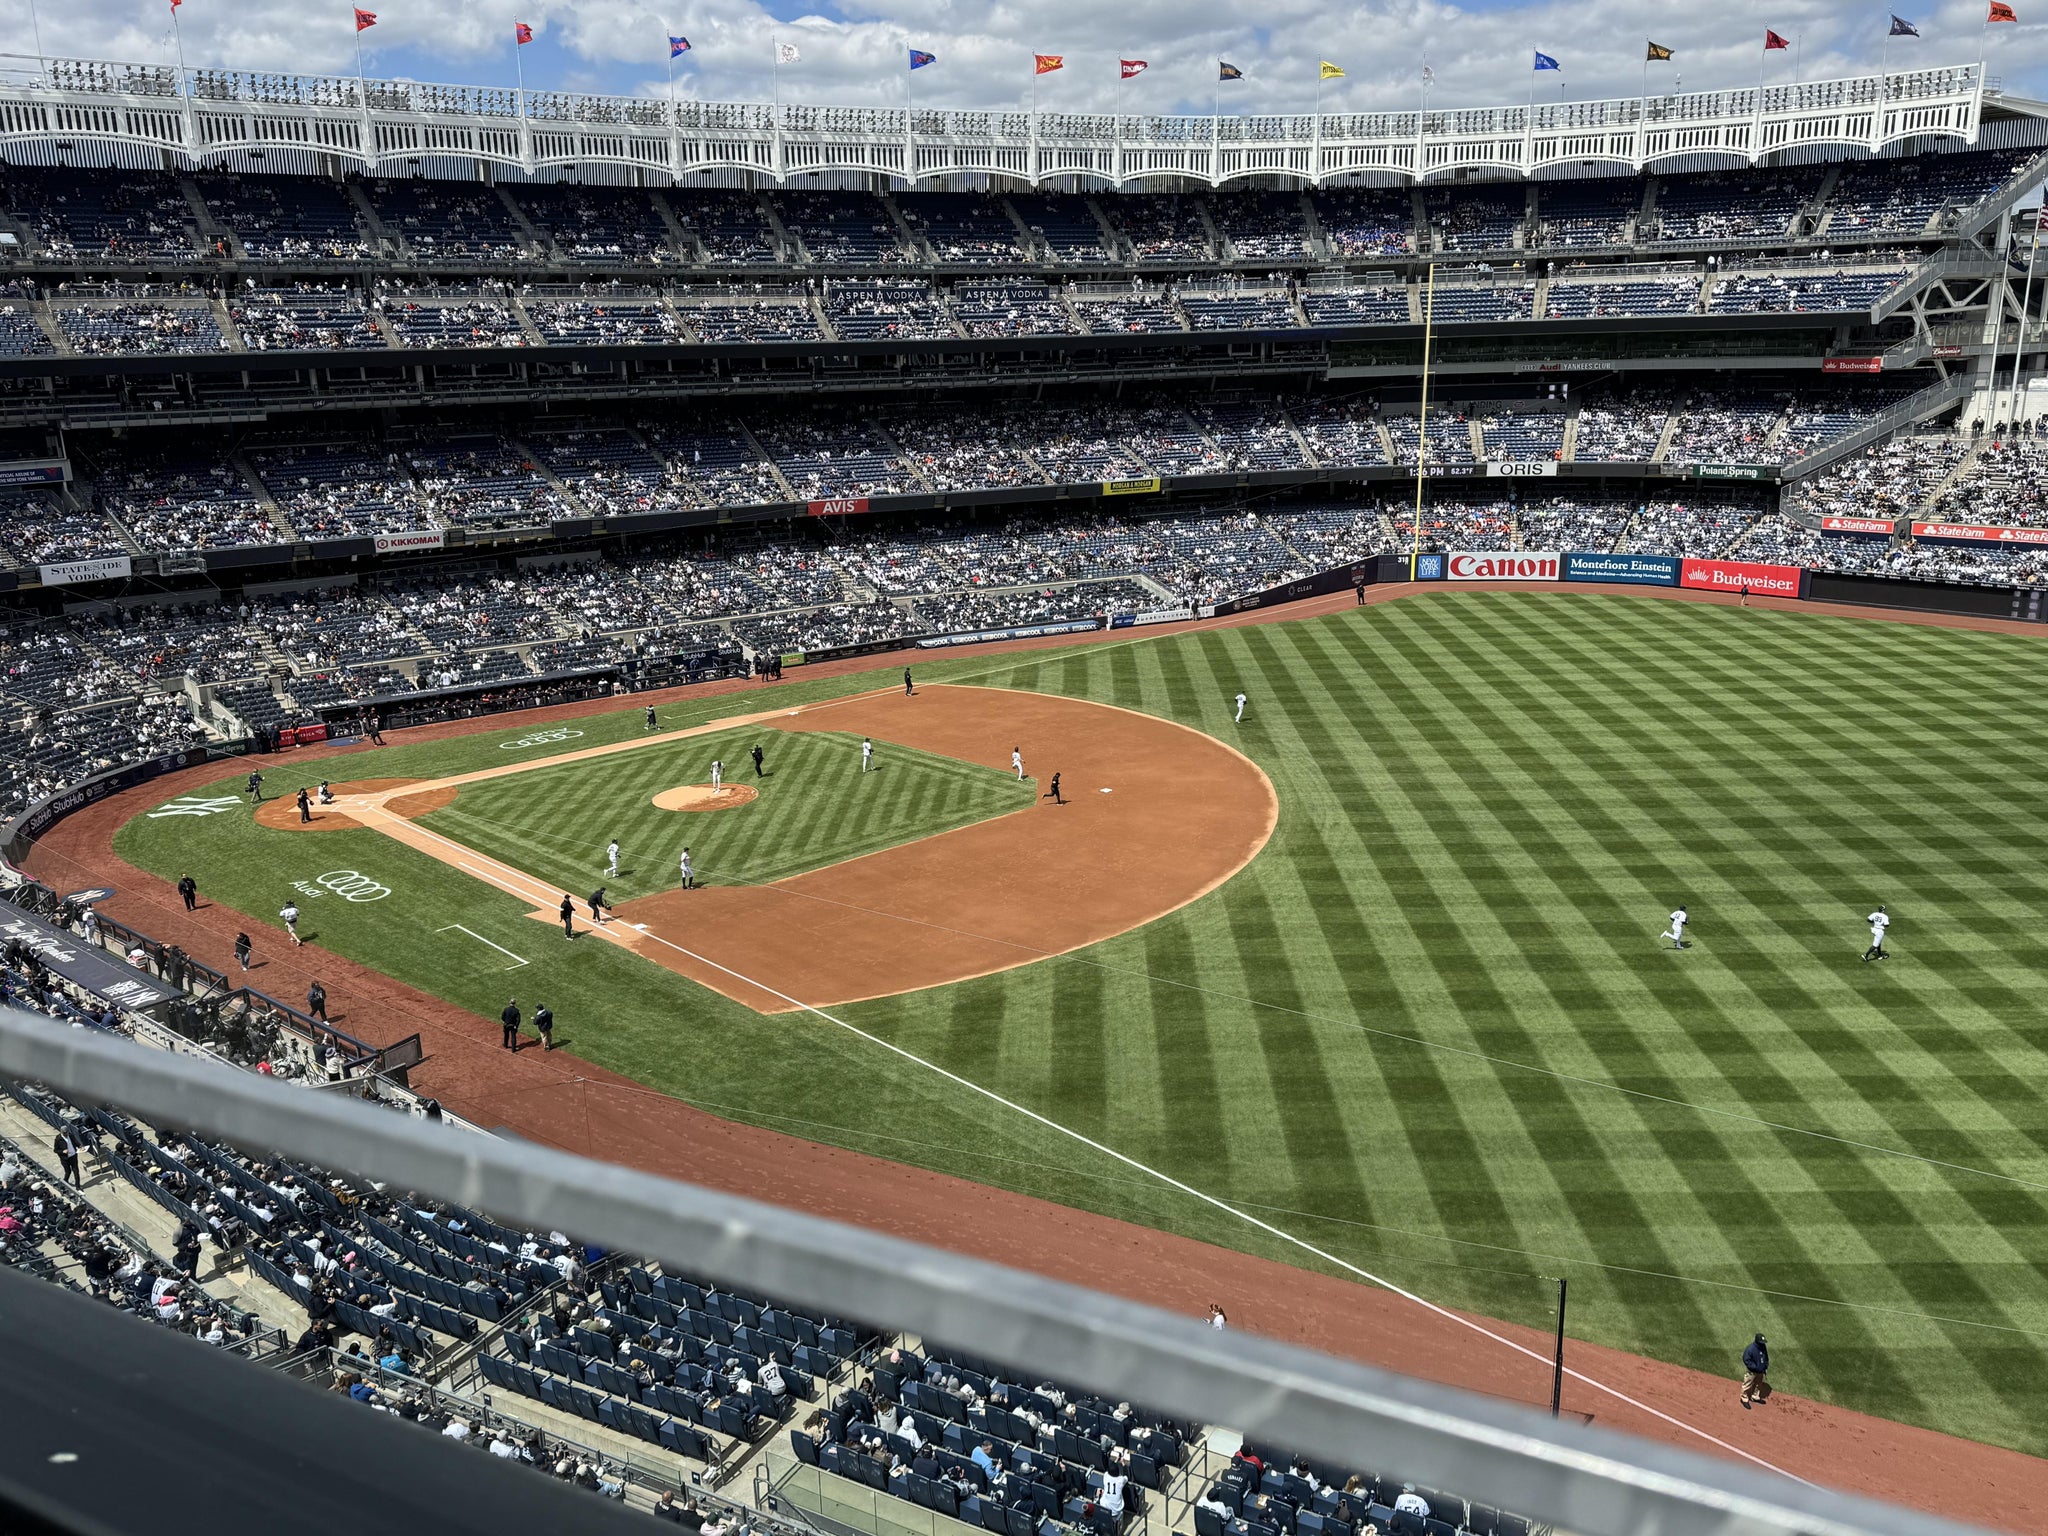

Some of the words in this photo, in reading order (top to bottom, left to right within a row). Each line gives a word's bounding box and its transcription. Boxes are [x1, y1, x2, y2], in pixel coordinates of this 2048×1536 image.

[838, 291, 874, 300] ASPEN
[886, 291, 922, 299] VODKA
[966, 290, 999, 299] ASPEN
[1010, 290, 1044, 298] VODKA
[1539, 363, 1561, 371] Audi
[1564, 362, 1593, 370] YANKEES
[1840, 362, 1879, 370] Budweiser
[1430, 467, 1444, 476] PM
[1500, 463, 1543, 476] ORIS
[1699, 465, 1728, 476] Poland
[1728, 465, 1759, 479] Spring
[822, 501, 855, 513] AVIS
[391, 536, 440, 547] KIKKOMAN
[51, 561, 123, 576] STATESIDE
[1450, 555, 1557, 577] Canon
[1571, 558, 1629, 570] Montefiore
[1631, 561, 1672, 573] Einstein
[68, 572, 107, 582] VODKA
[1296, 584, 1313, 593] CLEAR
[52, 792, 85, 814] StubHub
[288, 880, 329, 899] Audi
[764, 1366, 778, 1381] 27
[1106, 1482, 1117, 1495] 11
